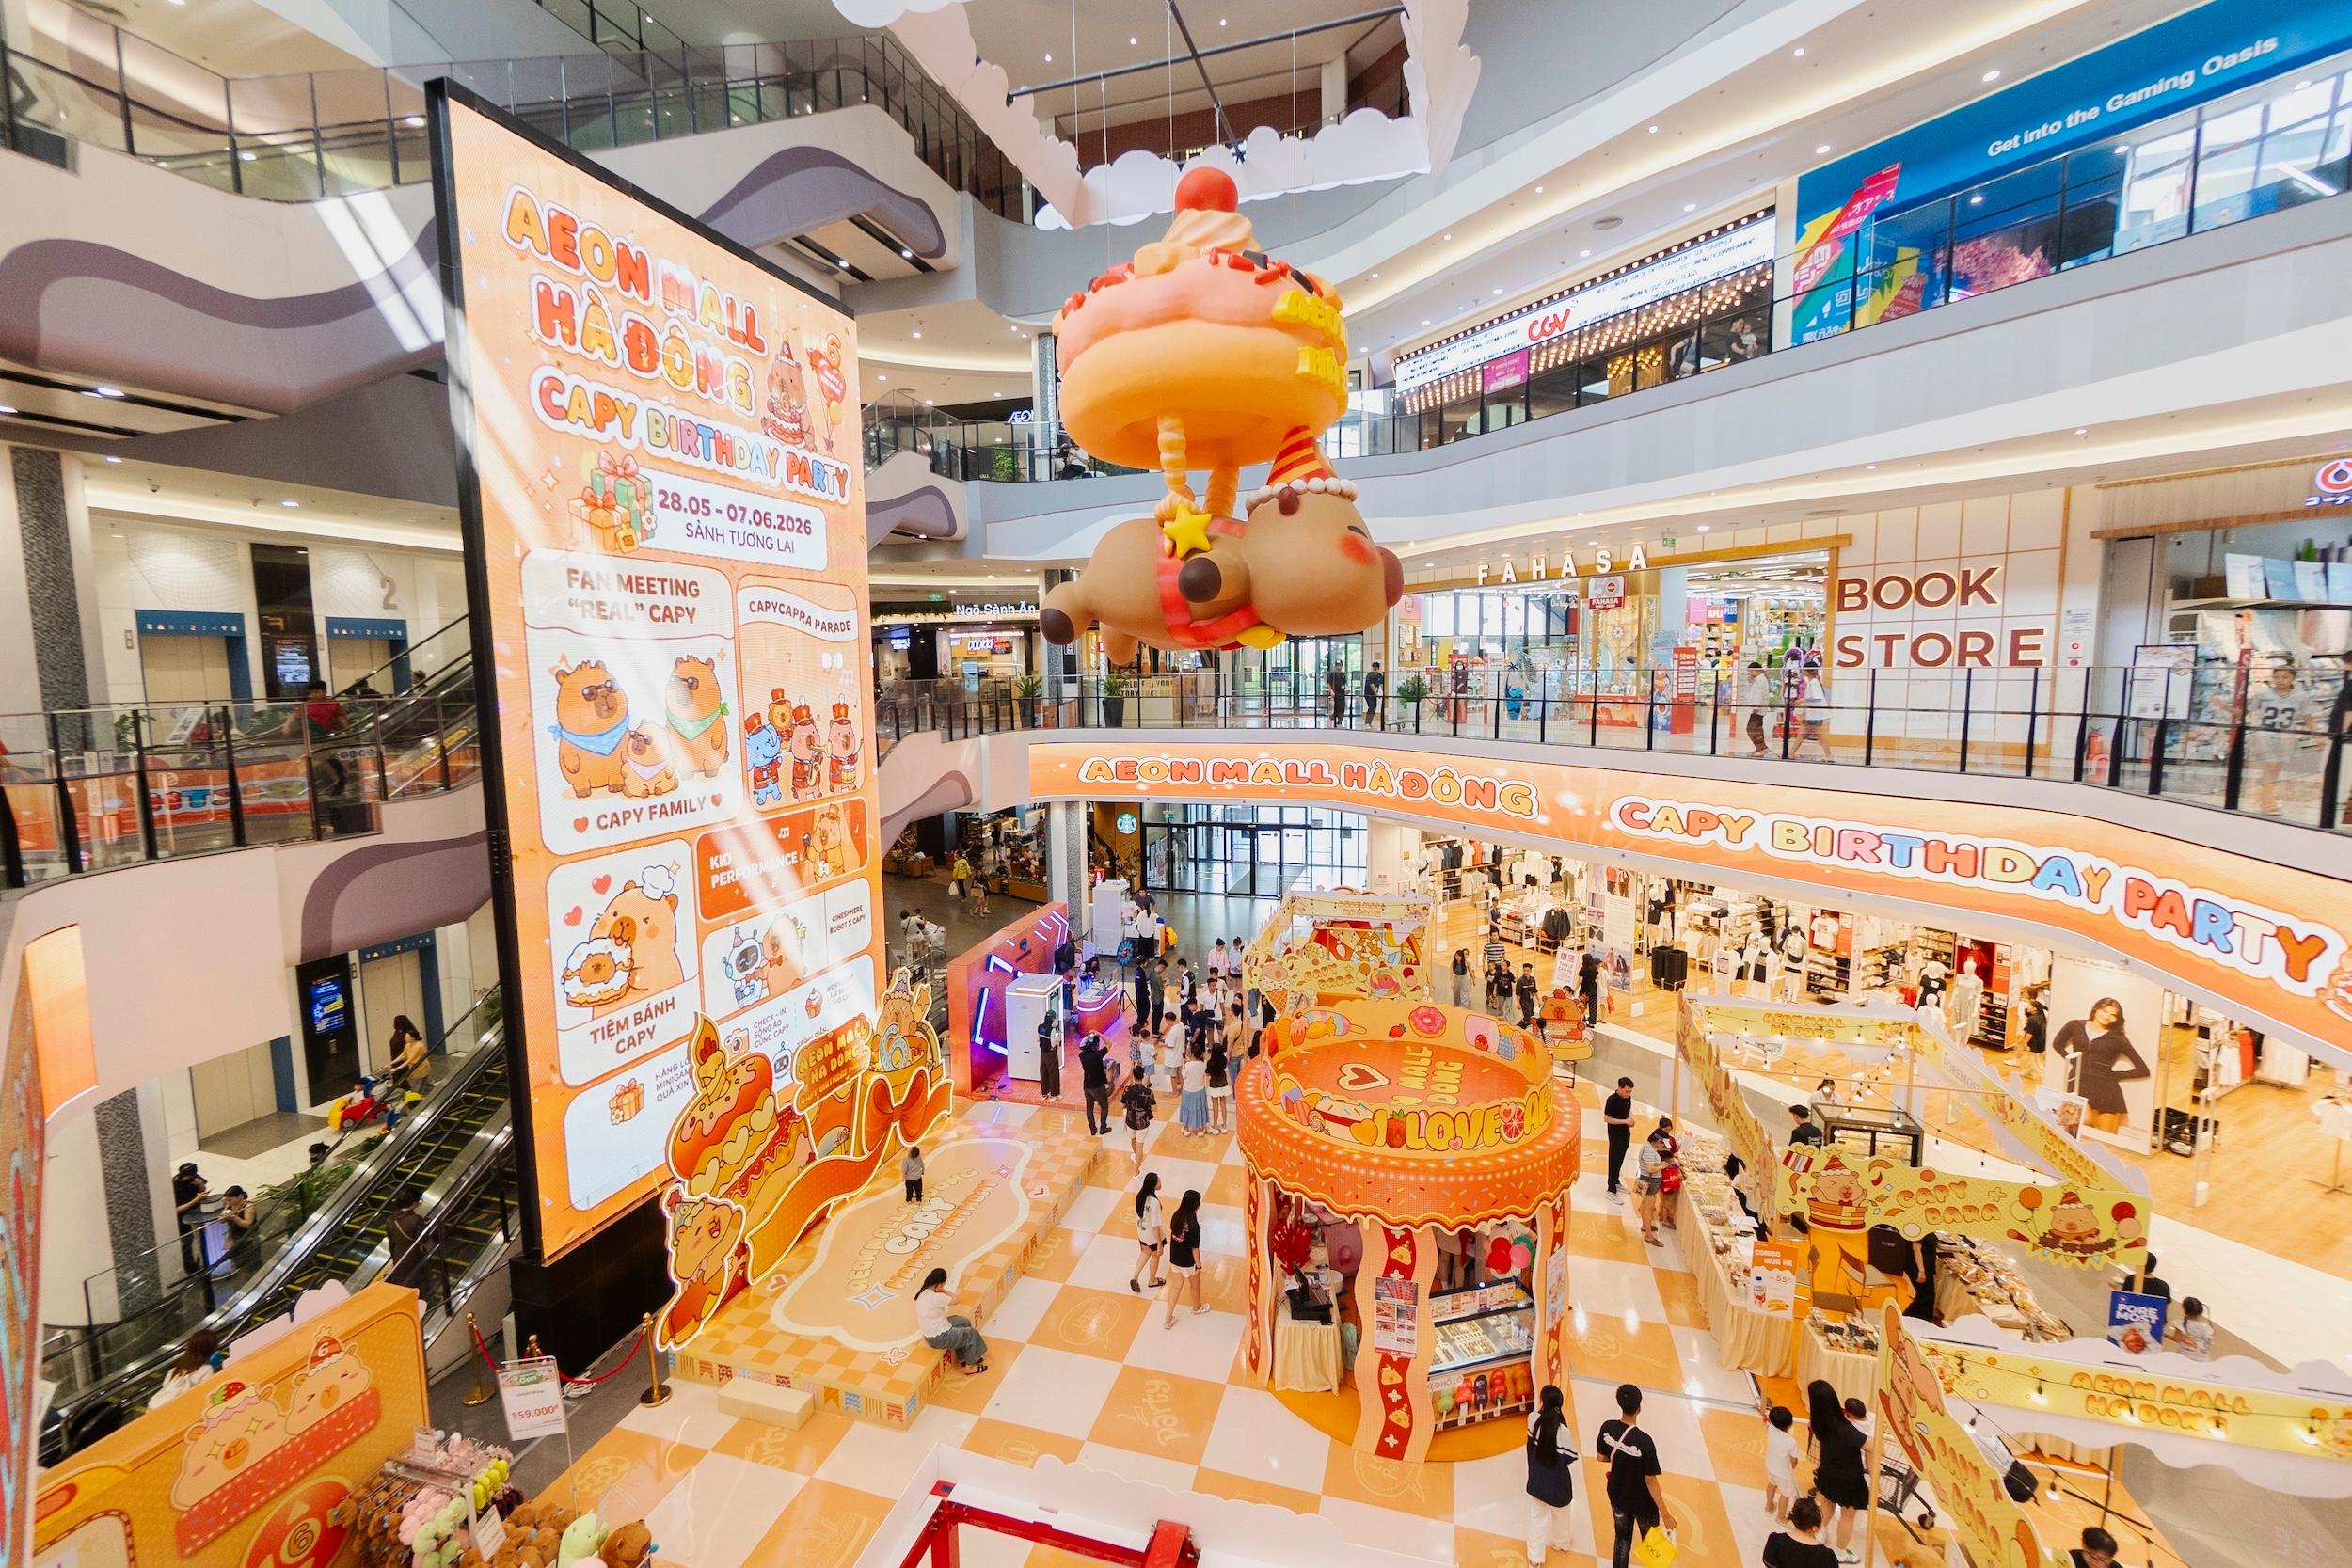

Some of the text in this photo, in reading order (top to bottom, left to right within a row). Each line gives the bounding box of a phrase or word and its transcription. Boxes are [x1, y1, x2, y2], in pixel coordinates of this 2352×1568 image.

[1987, 36, 2280, 158] Get into the Gaming Oasis
[505, 187, 768, 354] AEON MALL
[1528, 309, 1570, 341] CGV
[536, 282, 755, 414] HÀ ĐÔNG
[538, 374, 851, 500] CAPY BIRTHDAY PARTY
[658, 487, 711, 518] 28.05
[726, 502, 813, 536] 07.06.2026
[728, 528, 774, 552] TƯƠNG
[775, 534, 795, 555] LAI
[1477, 546, 1648, 586] FAHASA
[379, 575, 398, 610] 2
[617, 572, 701, 599] MEETING
[1592, 597, 1619, 606] FAHASA
[1836, 566, 2001, 613] BOOK
[648, 604, 697, 625] CAPY
[748, 599, 852, 634] CAPYCAPRA PARADE
[956, 601, 1036, 618] Ngõ Sành Ăn
[1836, 628, 2045, 668] STORE
[2262, 706, 2296, 730] 23
[1083, 756, 1536, 818] AEON MALL HÀ ĐÔNG
[596, 794, 707, 832] CAPY FAMILY
[710, 851, 799, 889] PERFORMANCE
[1618, 800, 2330, 984] CAPY BIRTHDAY PARTY
[829, 921, 848, 934] ROBOT
[852, 914, 866, 926] CAPY
[589, 997, 676, 1047] TIỆM BÁNH
[613, 1023, 658, 1056] CAPY
[753, 1014, 774, 1030] CHECK
[771, 1024, 790, 1040] CAPY
[799, 1042, 834, 1074] AEON
[837, 1019, 868, 1051] MALL
[810, 1045, 861, 1085] HA DONG
[879, 1022, 912, 1072] 6
[1397, 1046, 1434, 1091] MALL
[1426, 1060, 1465, 1105] DONG
[1375, 1108, 1389, 1148] I
[1405, 1103, 1503, 1151] LOVE
[1895, 1180, 1969, 1209] CAPY
[884, 1196, 957, 1255] CAPY
[1924, 1203, 2003, 1227] BARA
[1754, 1248, 1782, 1258] COMBO
[2116, 1310, 2159, 1327] MOST
[2117, 1302, 2159, 1319] FORE
[316, 1341, 333, 1356] 6
[2070, 1371, 2253, 1417] AEON MALL
[2137, 1402, 2230, 1440] DONG
[1938, 1436, 1981, 1498] CAPY
[1952, 1482, 2002, 1557] BARA
[287, 1521, 314, 1559] 6
